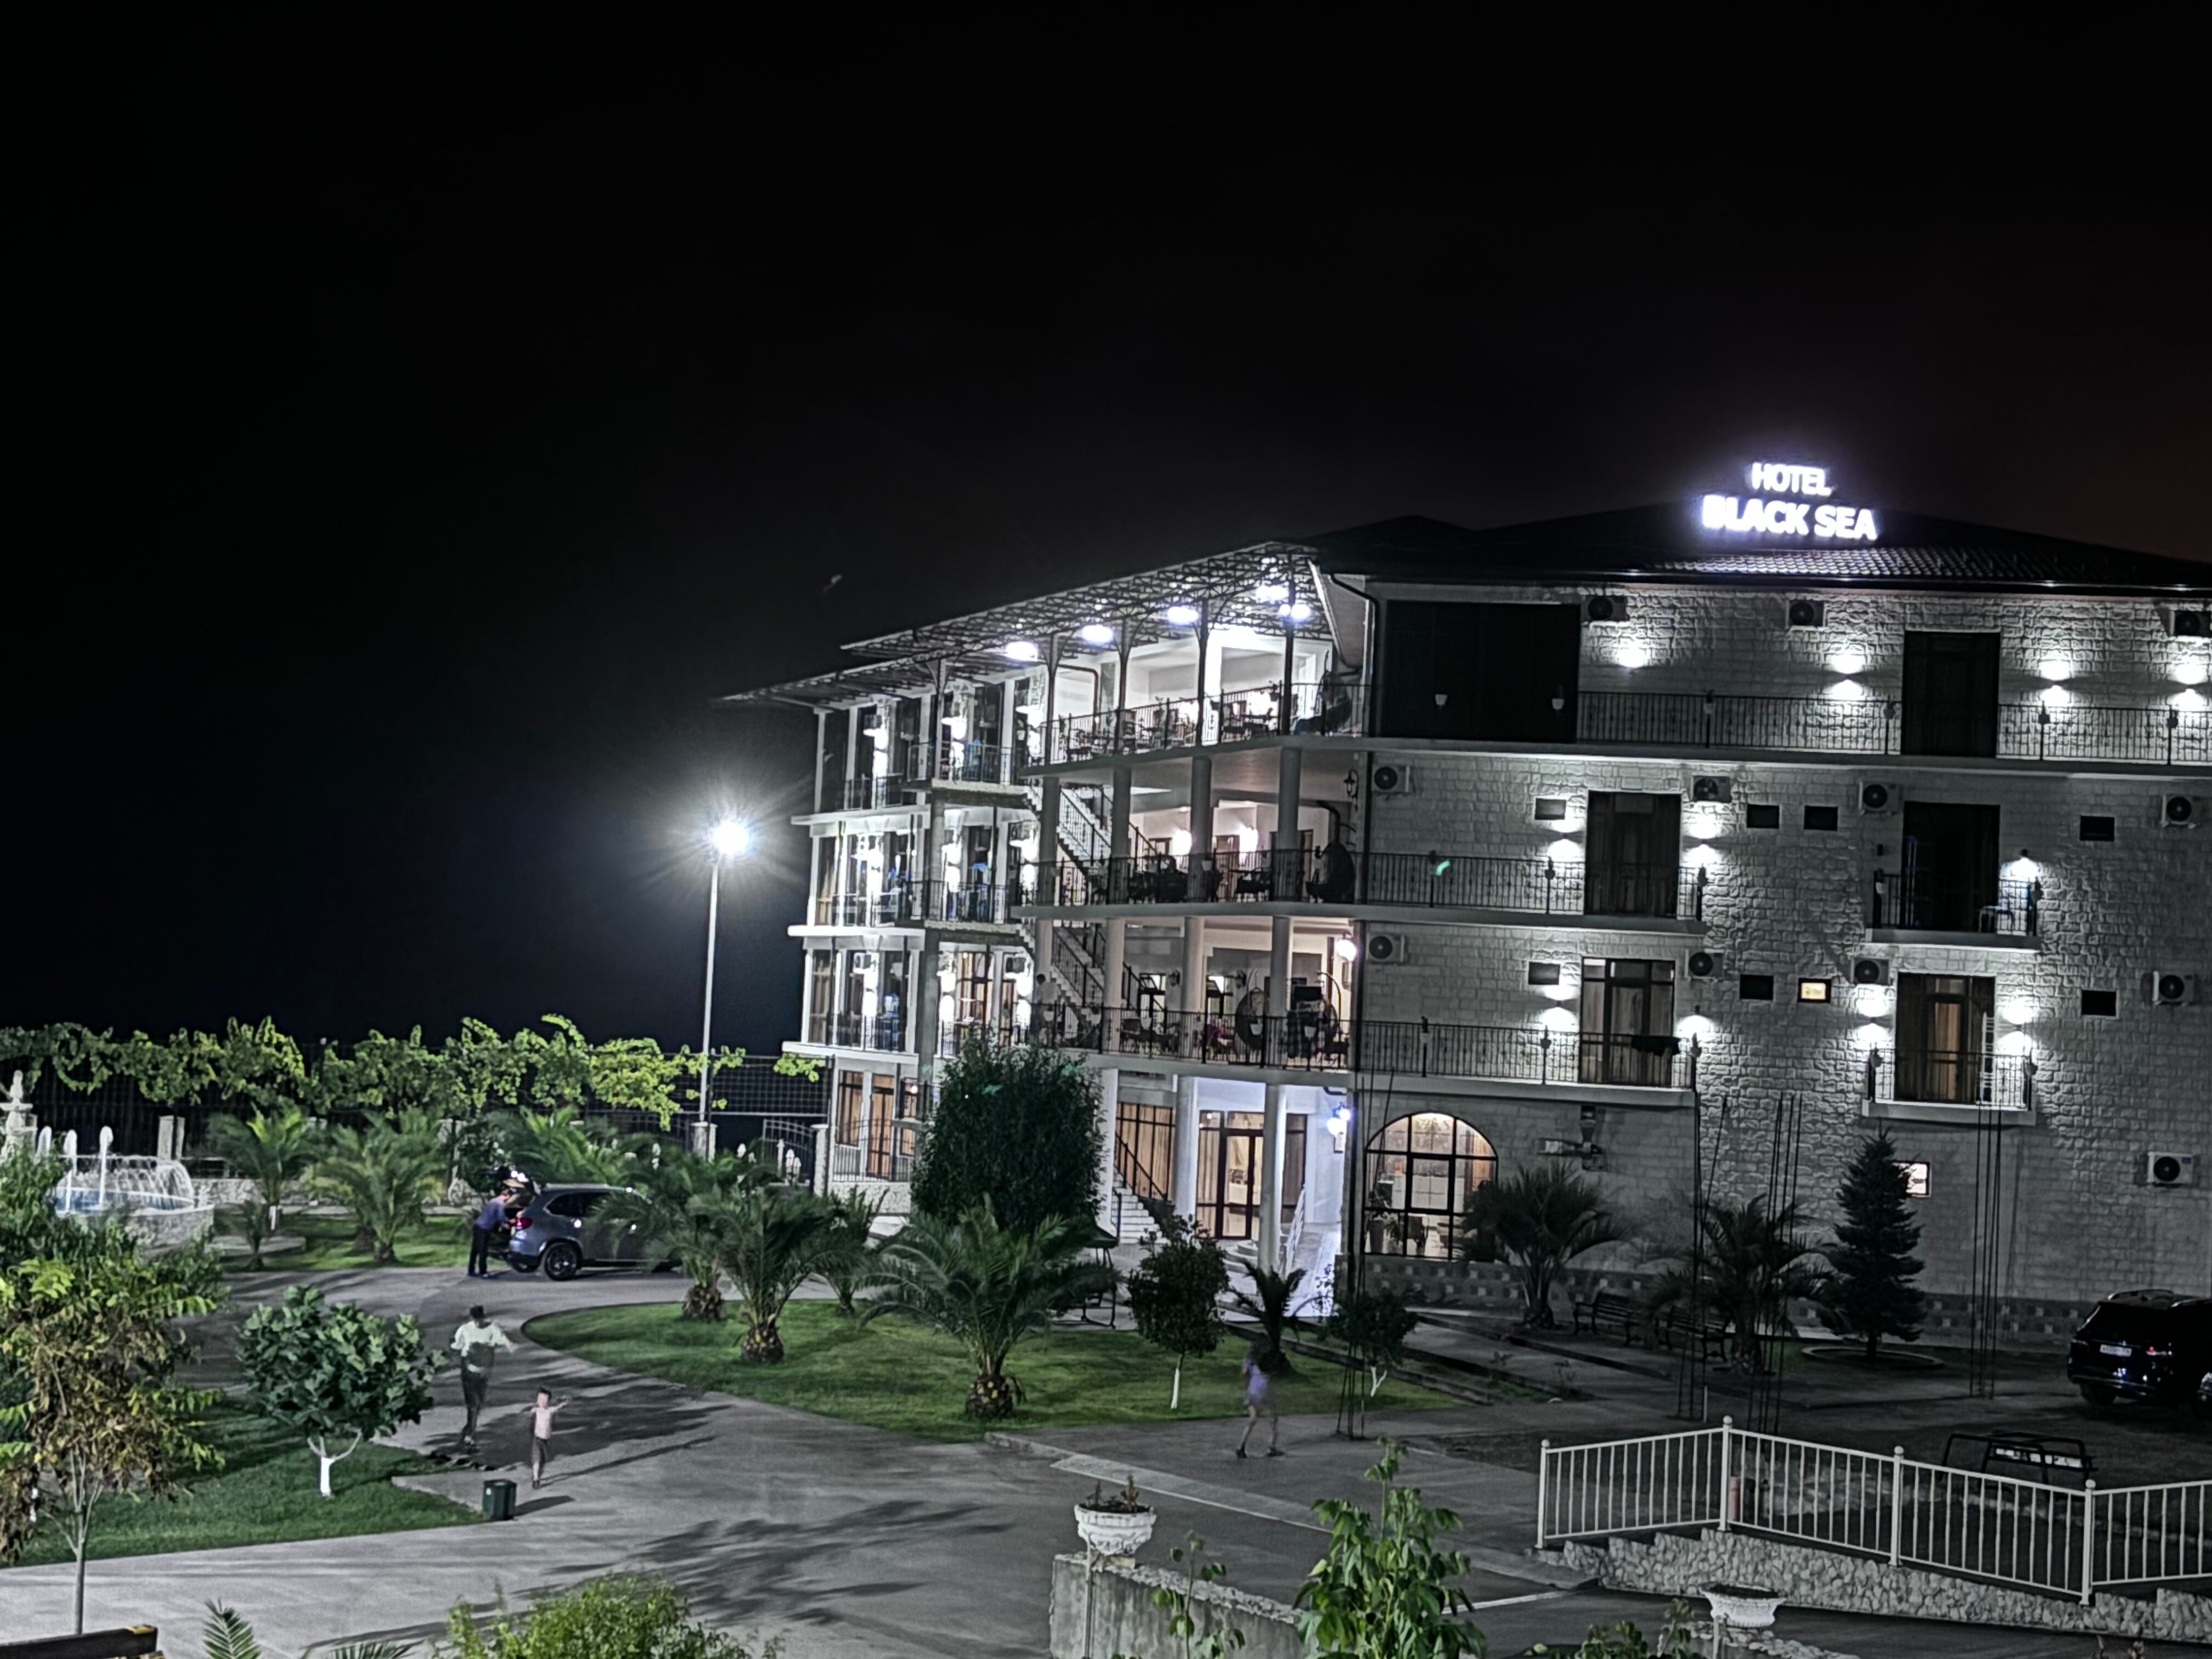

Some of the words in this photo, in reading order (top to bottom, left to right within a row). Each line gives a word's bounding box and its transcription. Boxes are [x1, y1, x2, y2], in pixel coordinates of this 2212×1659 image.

[1751, 462, 1832, 496] HOTEL
[1701, 494, 1810, 535] BLACK
[1814, 505, 1877, 540] SEA
